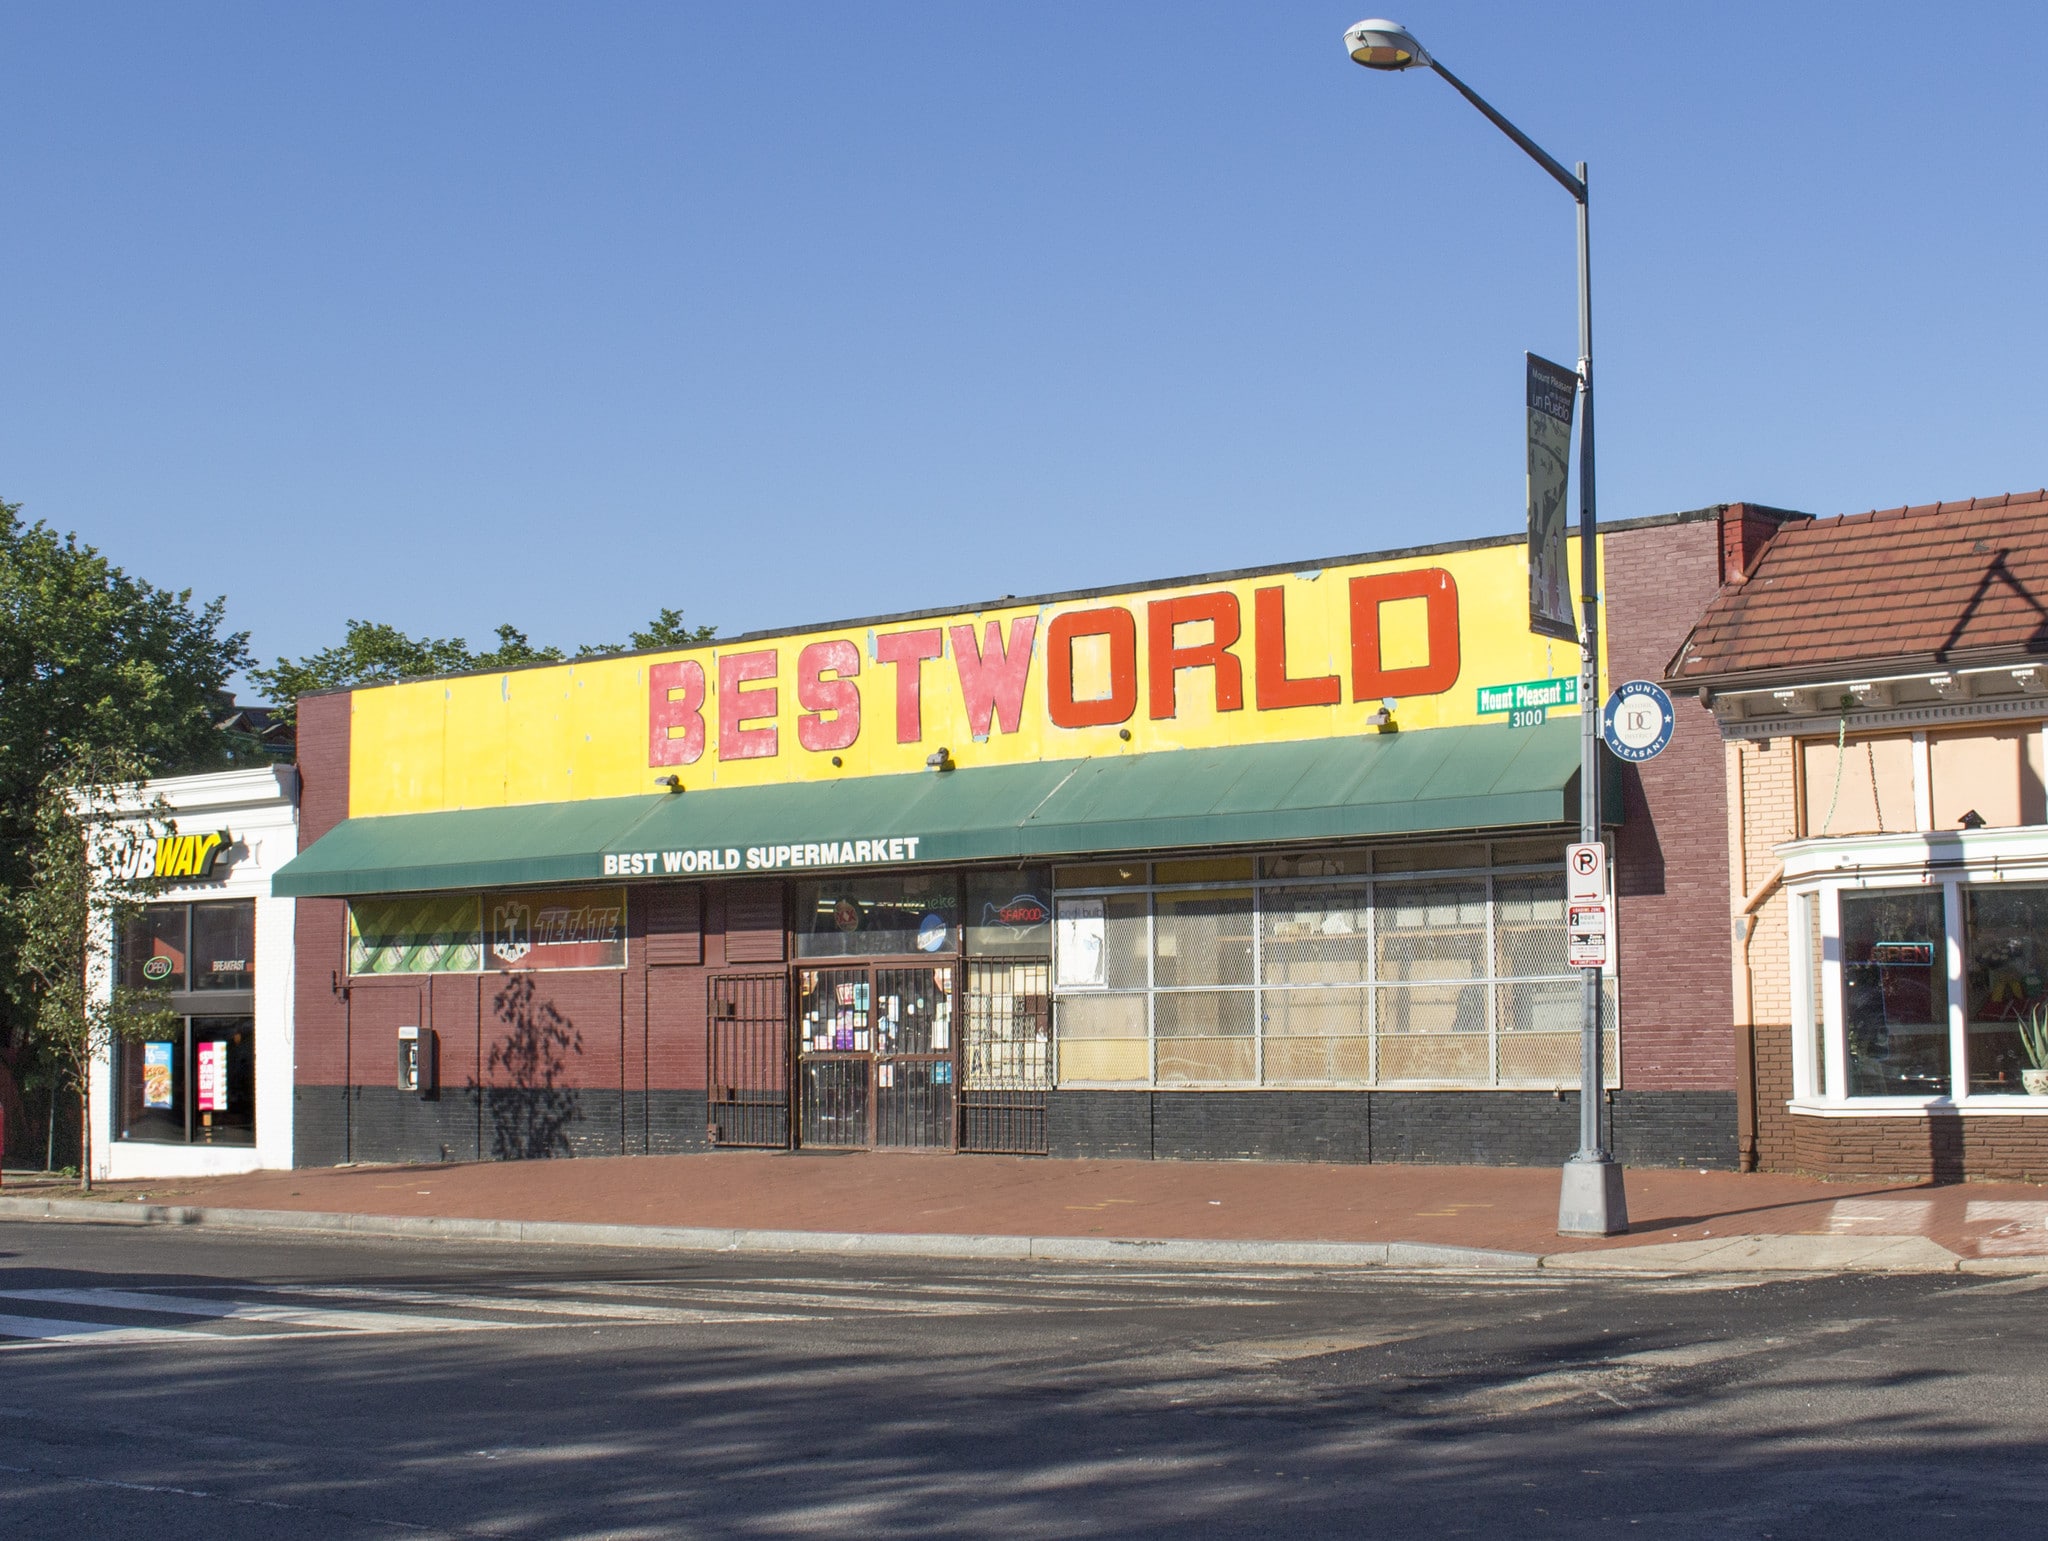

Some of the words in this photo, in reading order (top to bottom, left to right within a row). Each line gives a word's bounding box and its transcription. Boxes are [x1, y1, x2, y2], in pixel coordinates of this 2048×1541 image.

[1565, 680, 1575, 690] ST
[1481, 687, 1514, 711] Mount
[1516, 681, 1562, 707] Pleasant
[1565, 691, 1575, 702] NW
[1513, 709, 1543, 728] 3100
[1612, 736, 1665, 758] PLEASANT
[604, 853, 648, 875] BEST
[653, 848, 741, 873] WORLD
[746, 837, 919, 870] SUPERMARKET
[901, 895, 956, 912] Heineke
[1000, 908, 1043, 922] SEAFOOD
[1571, 913, 1578, 925] 2
[534, 904, 621, 946] TECATE
[1871, 946, 1929, 962] OPEN
[147, 962, 169, 974] OPEN
[212, 960, 245, 972] BREAKFAST
